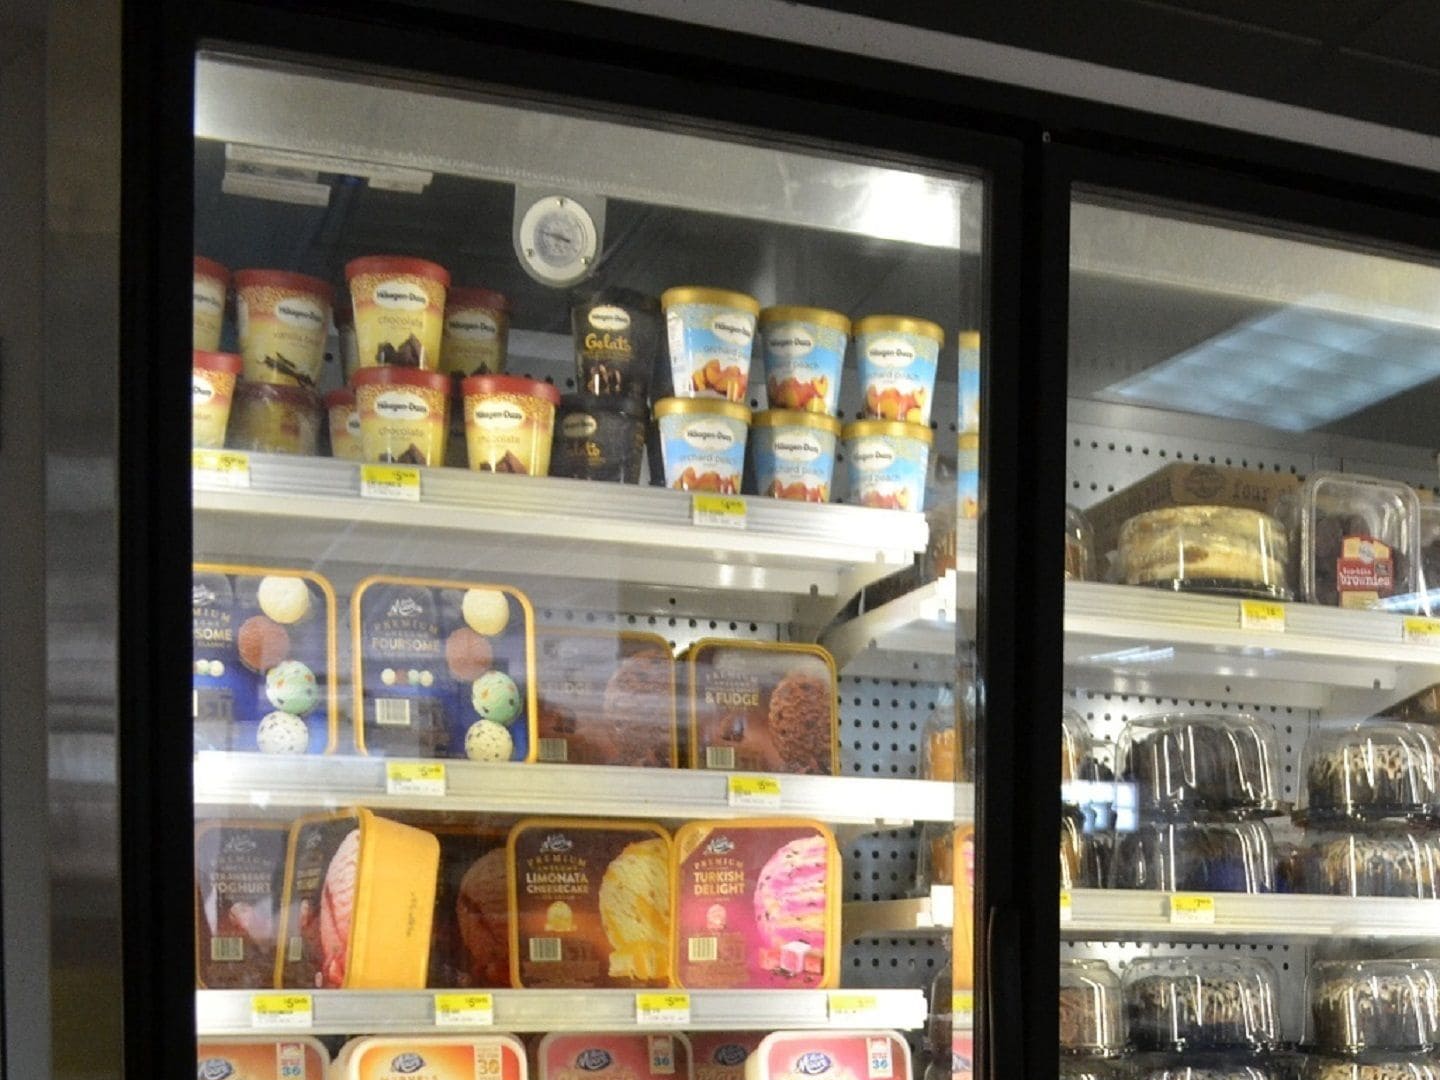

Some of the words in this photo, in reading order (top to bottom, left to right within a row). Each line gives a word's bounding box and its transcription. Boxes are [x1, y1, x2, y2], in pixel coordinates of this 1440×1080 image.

[585, 333, 632, 351] Gelato
[1340, 573, 1391, 586] brownies
[371, 636, 440, 651] FOURSOME
[716, 691, 760, 707] FUDGE
[526, 872, 589, 885] LIMONATA
[694, 871, 745, 882] TURKISH
[210, 881, 272, 893] YOGHURT
[526, 884, 589, 895] CHEESECAKE
[694, 883, 745, 896] DELIGHT
